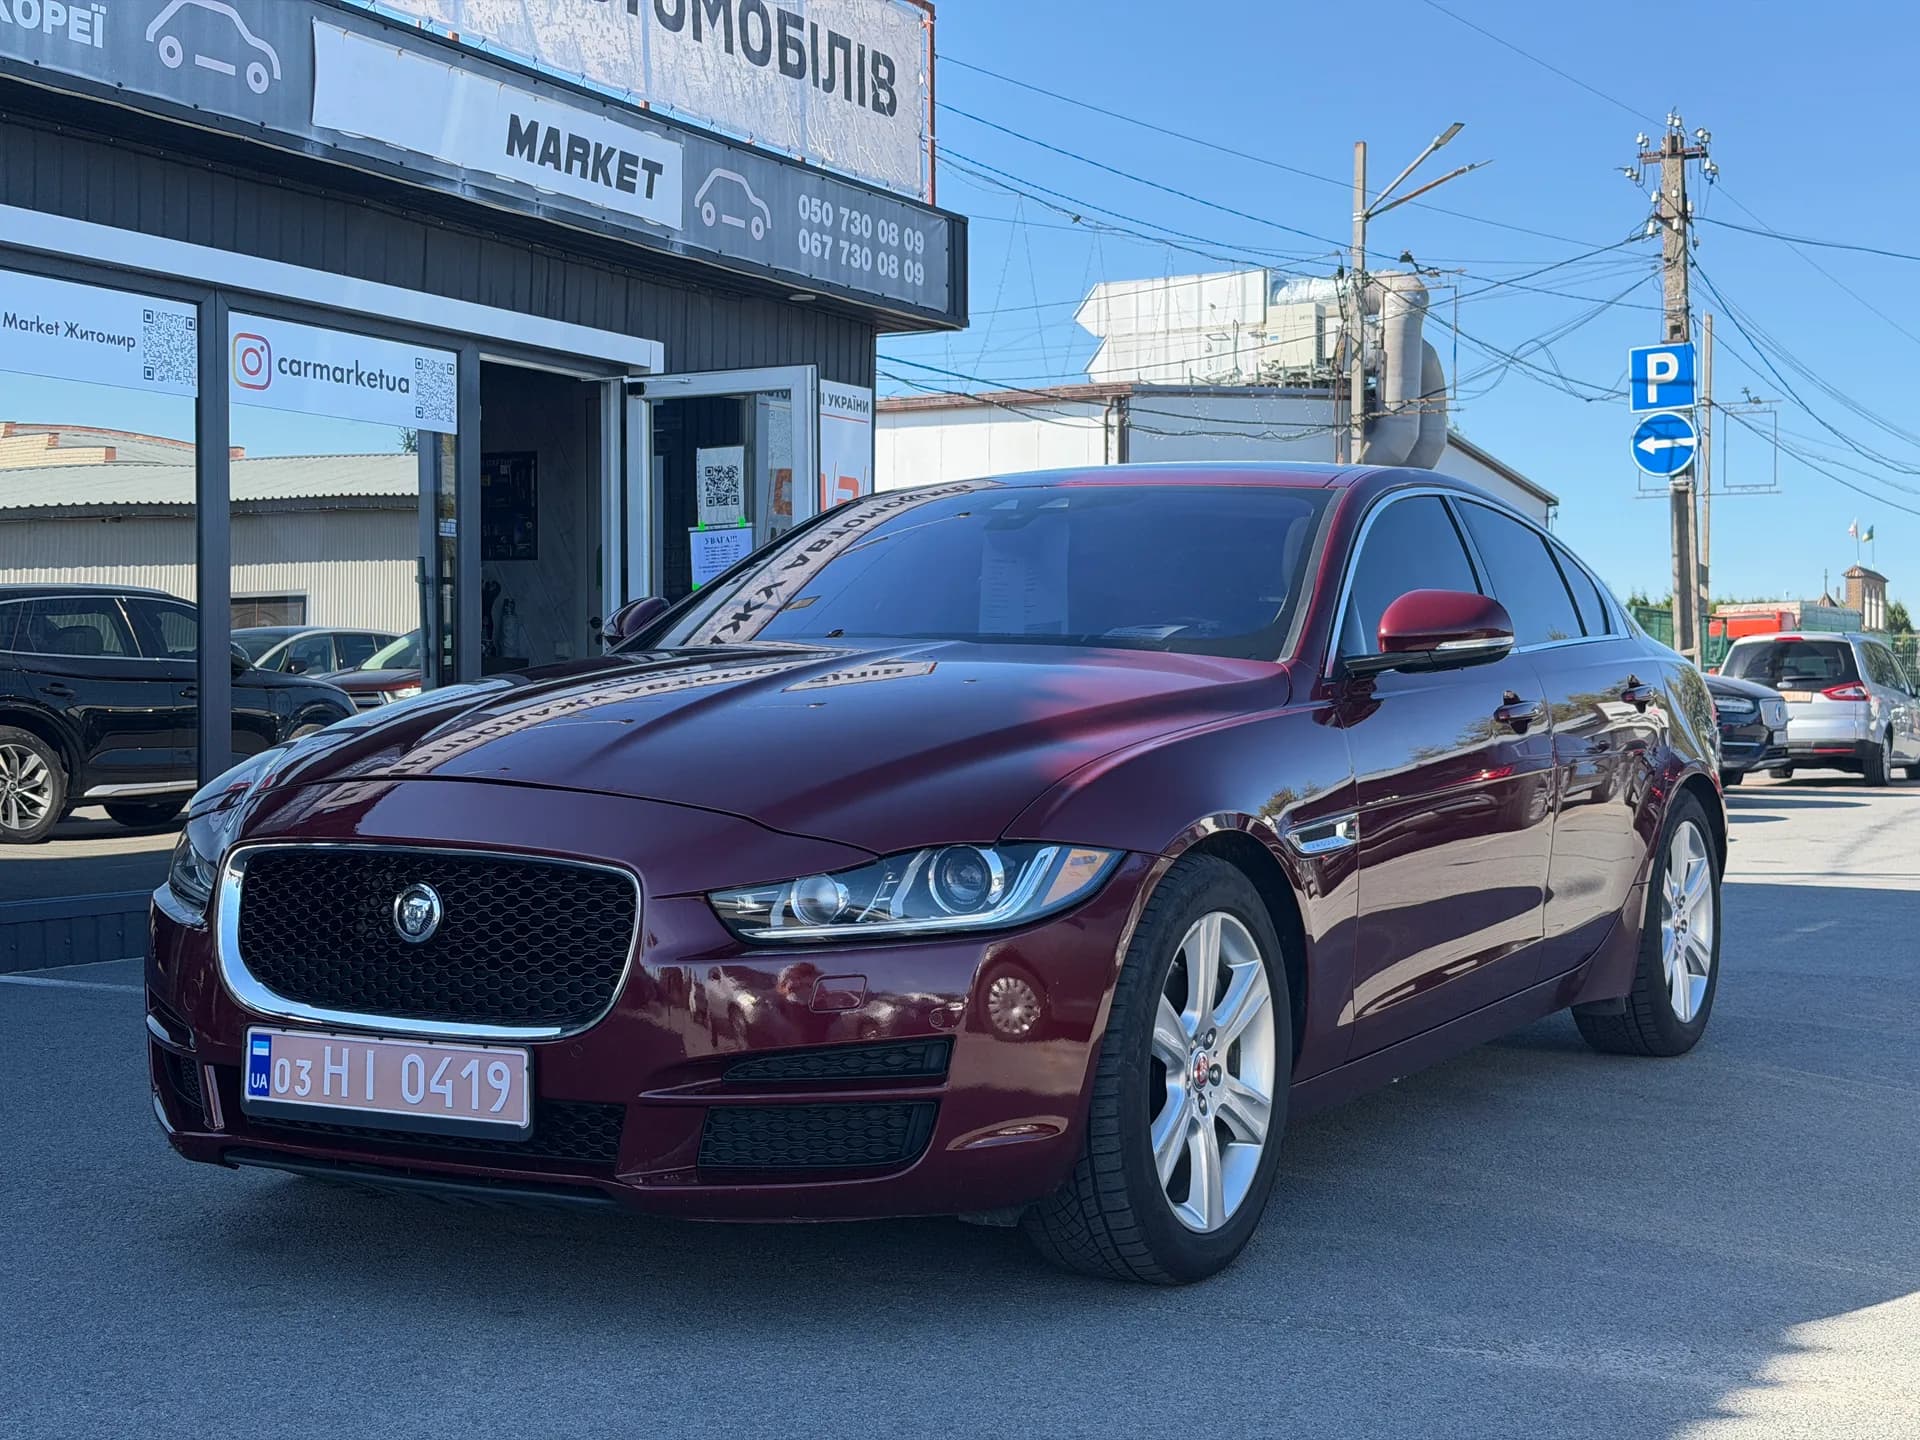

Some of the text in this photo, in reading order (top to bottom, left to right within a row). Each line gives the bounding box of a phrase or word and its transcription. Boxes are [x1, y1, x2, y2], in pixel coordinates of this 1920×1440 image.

[505, 113, 664, 200] MARKET
[797, 193, 925, 256] 050 730 08 09
[797, 229, 925, 287] 067 730 08 09
[2, 311, 137, 353] Market Житомир
[277, 353, 411, 395] carmarketua
[1647, 352, 1679, 404] P
[828, 393, 869, 414] УКРАЇНИ
[250, 1072, 268, 1089] UA
[273, 1057, 312, 1097] 03
[400, 1052, 512, 1113] 0419
